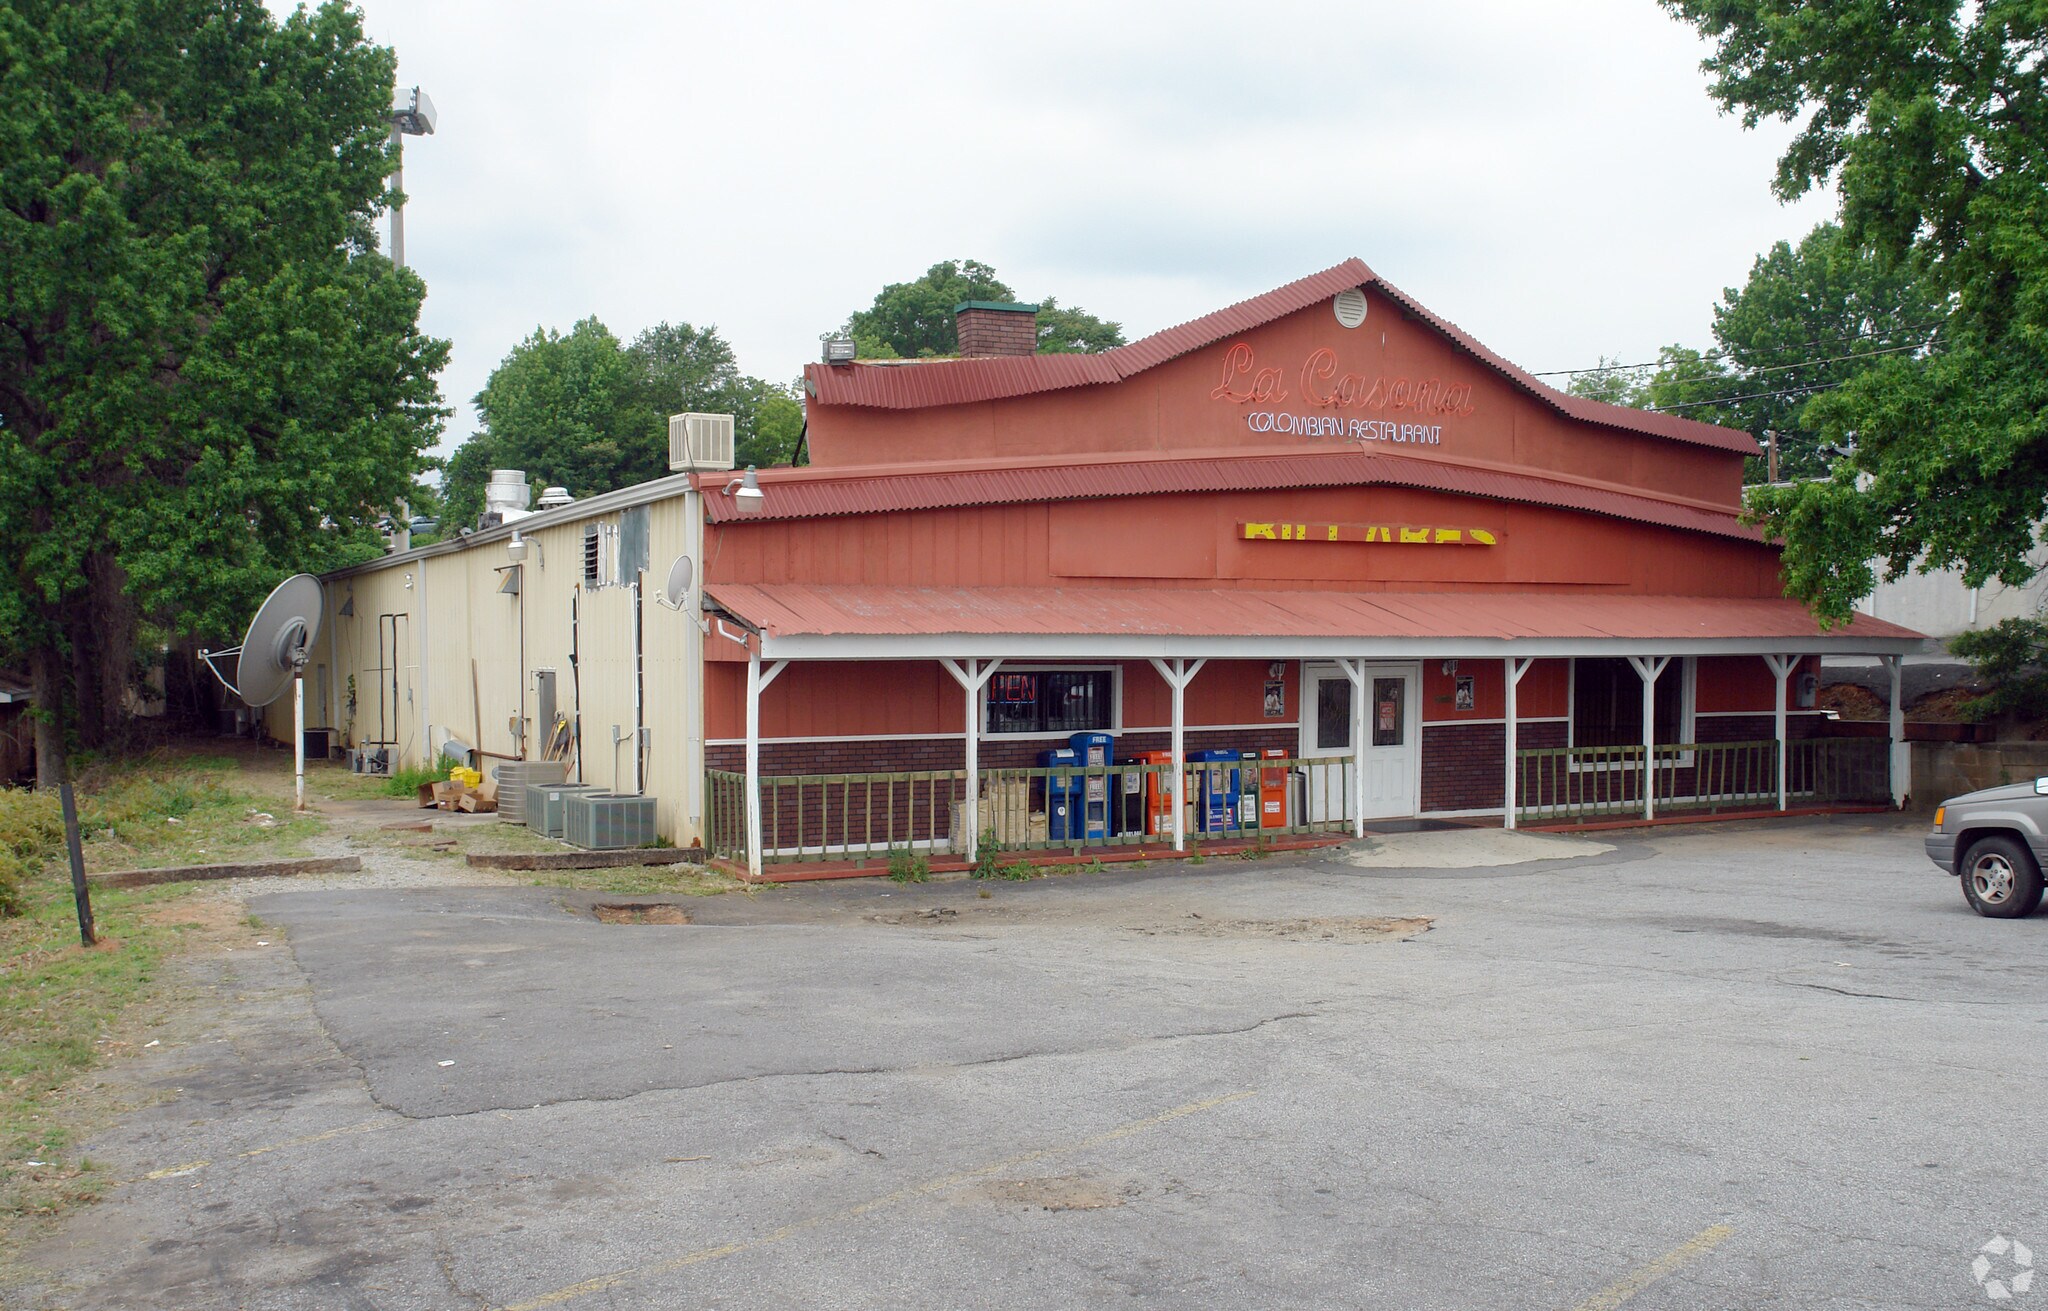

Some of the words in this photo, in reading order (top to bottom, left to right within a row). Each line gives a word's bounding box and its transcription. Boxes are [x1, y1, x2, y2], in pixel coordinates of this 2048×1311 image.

[1211, 342, 1288, 403] La
[1300, 347, 1475, 417] Casona
[1248, 412, 1344, 437] COLOMBIAN
[986, 674, 1036, 701] PEN
[1092, 735, 1107, 744] FREE
